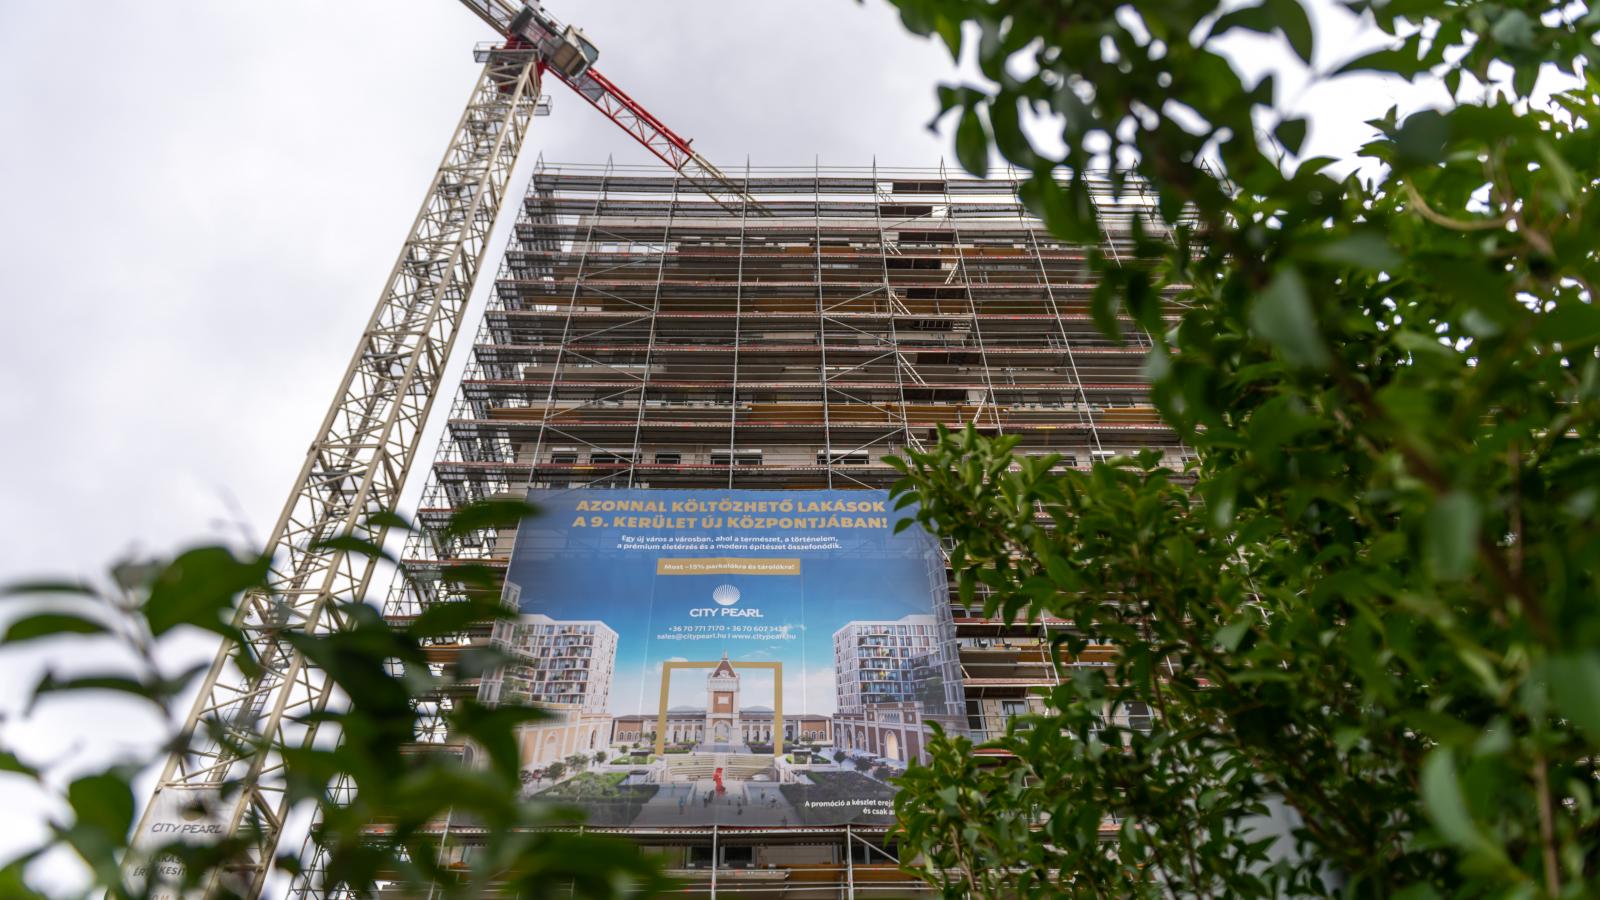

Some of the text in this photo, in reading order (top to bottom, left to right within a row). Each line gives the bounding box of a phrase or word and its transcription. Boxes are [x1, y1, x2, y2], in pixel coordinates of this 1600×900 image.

[576, 498, 885, 513] AZONNAL KÖLTÖZHETŐ LAKÁSOK
[572, 514, 888, 529] A 9. KERÜLET ÚJ KÖZPONTJÁBAN!
[621, 535, 636, 543] Egy
[637, 535, 645, 543] új
[791, 535, 838, 543] történelem,
[749, 543, 787, 551] építészet
[689, 608, 764, 618] CITY PEARL
[811, 800, 845, 808] promóció
[151, 823, 223, 833] CITY PEARL
